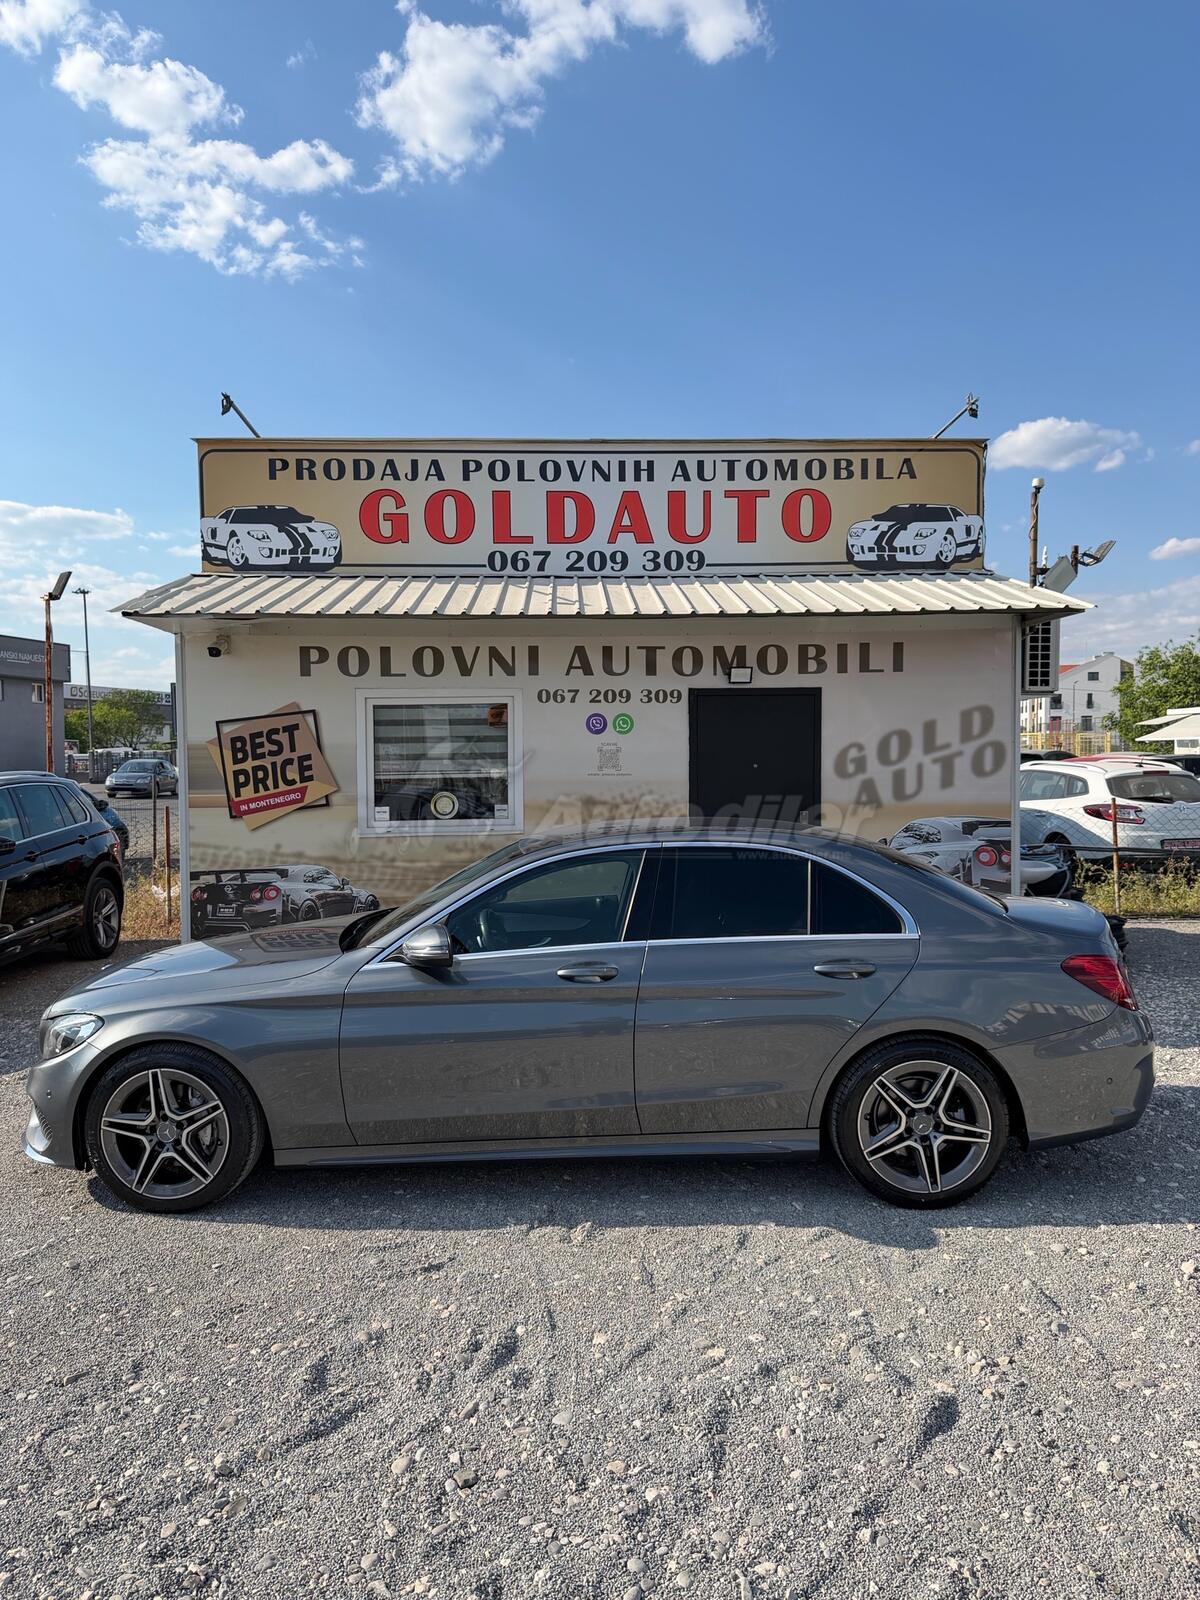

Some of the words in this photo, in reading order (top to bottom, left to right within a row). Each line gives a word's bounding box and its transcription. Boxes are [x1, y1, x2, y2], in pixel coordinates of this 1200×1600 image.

[268, 458, 445, 481] PRODAJA
[462, 459, 654, 482] POLOVNIH
[672, 458, 917, 481] AUTOMOBILA
[359, 488, 832, 545] GOLDAUTO
[487, 550, 551, 573] 067
[565, 550, 628, 573] 209
[642, 549, 705, 572] 309
[300, 646, 540, 677] POLOVNI
[565, 642, 905, 677] AUTOMOBILI
[537, 688, 579, 704] 067
[589, 688, 632, 704] 209
[640, 688, 683, 704] 309
[230, 723, 299, 765] BEST
[833, 704, 994, 780] GOLD
[232, 753, 315, 798] PRICE
[854, 740, 1007, 814] AUTO
[240, 803, 248, 812] IN
[249, 792, 302, 809] MONTENEGRO
